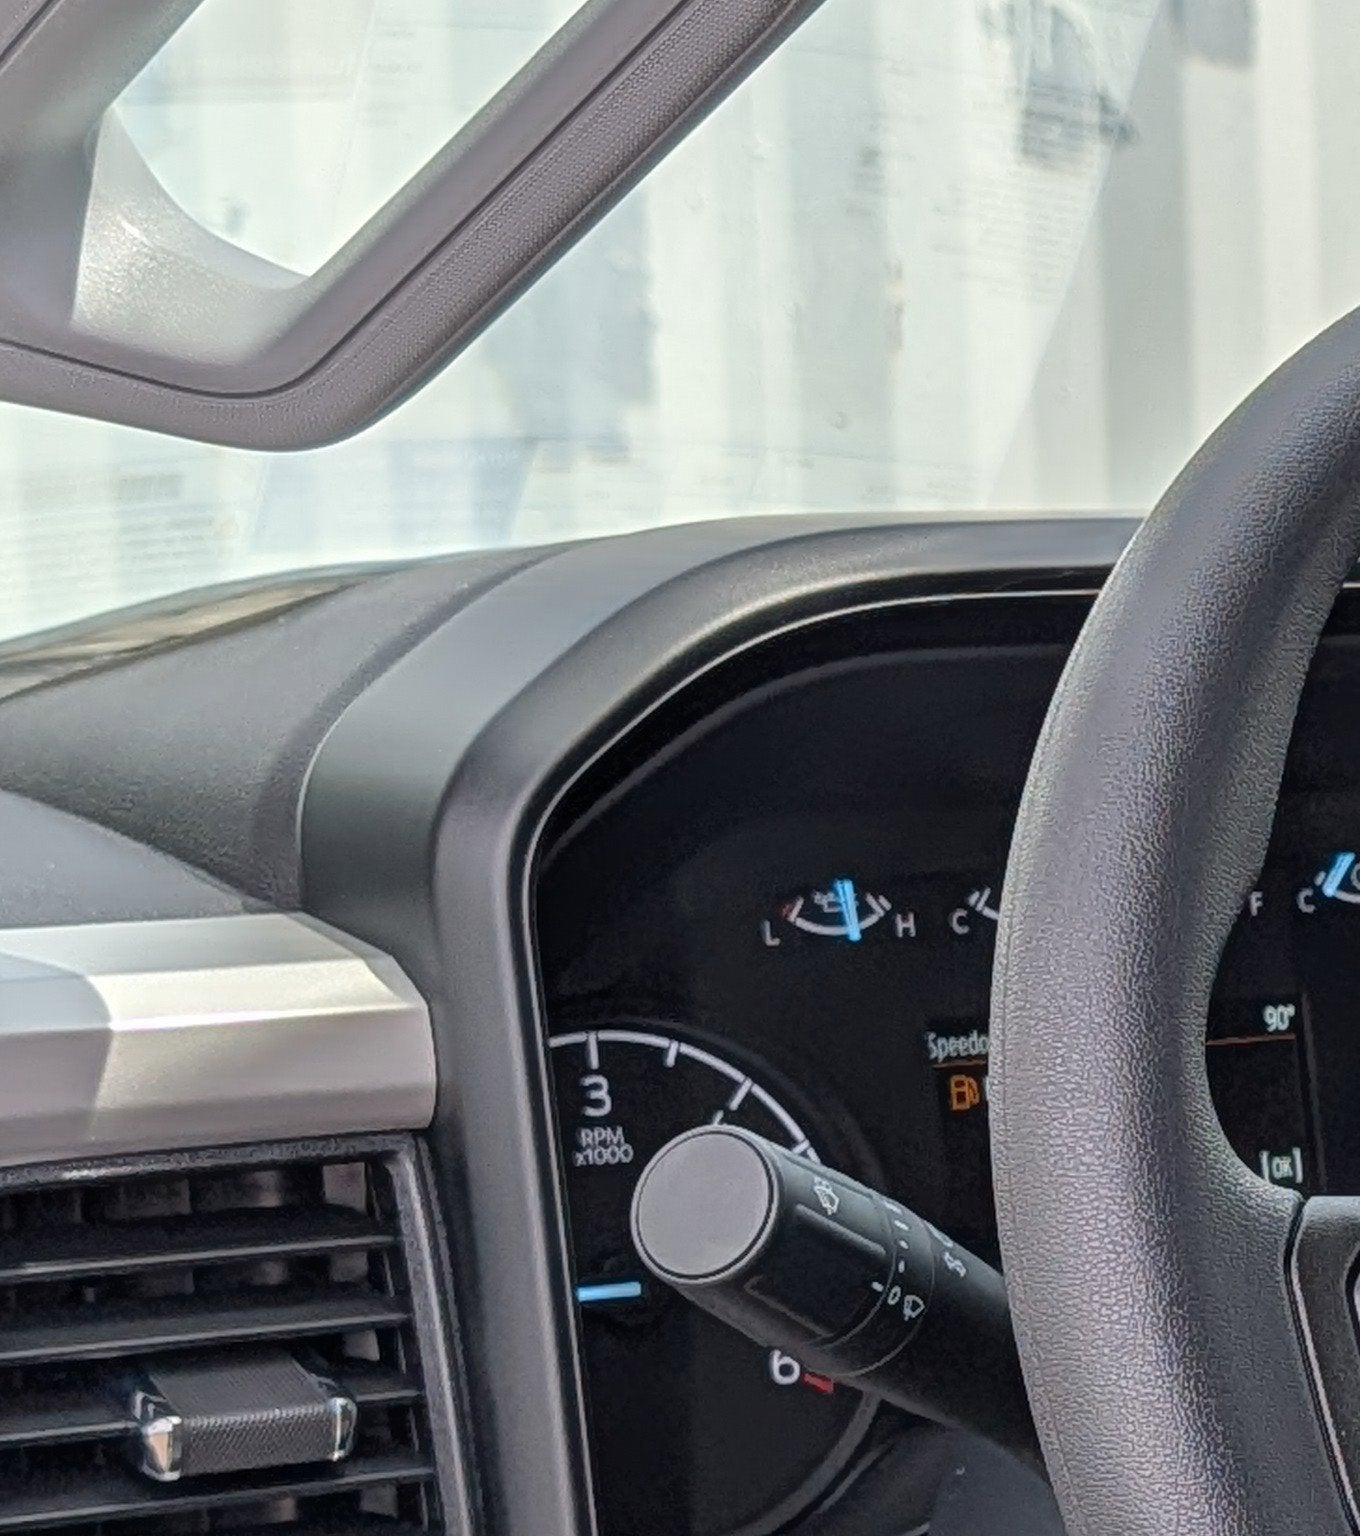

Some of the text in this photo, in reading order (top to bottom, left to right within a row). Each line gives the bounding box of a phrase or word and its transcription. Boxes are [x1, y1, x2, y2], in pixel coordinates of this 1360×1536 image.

[1249, 891, 1264, 917] F
[1298, 889, 1317, 914] C
[763, 921, 780, 947] L
[897, 912, 915, 938] H
[949, 907, 968, 935] C
[581, 1075, 613, 1118] 3
[580, 1127, 626, 1147] RPM
[575, 1142, 634, 1167] x1000
[769, 1349, 801, 1385] 6
